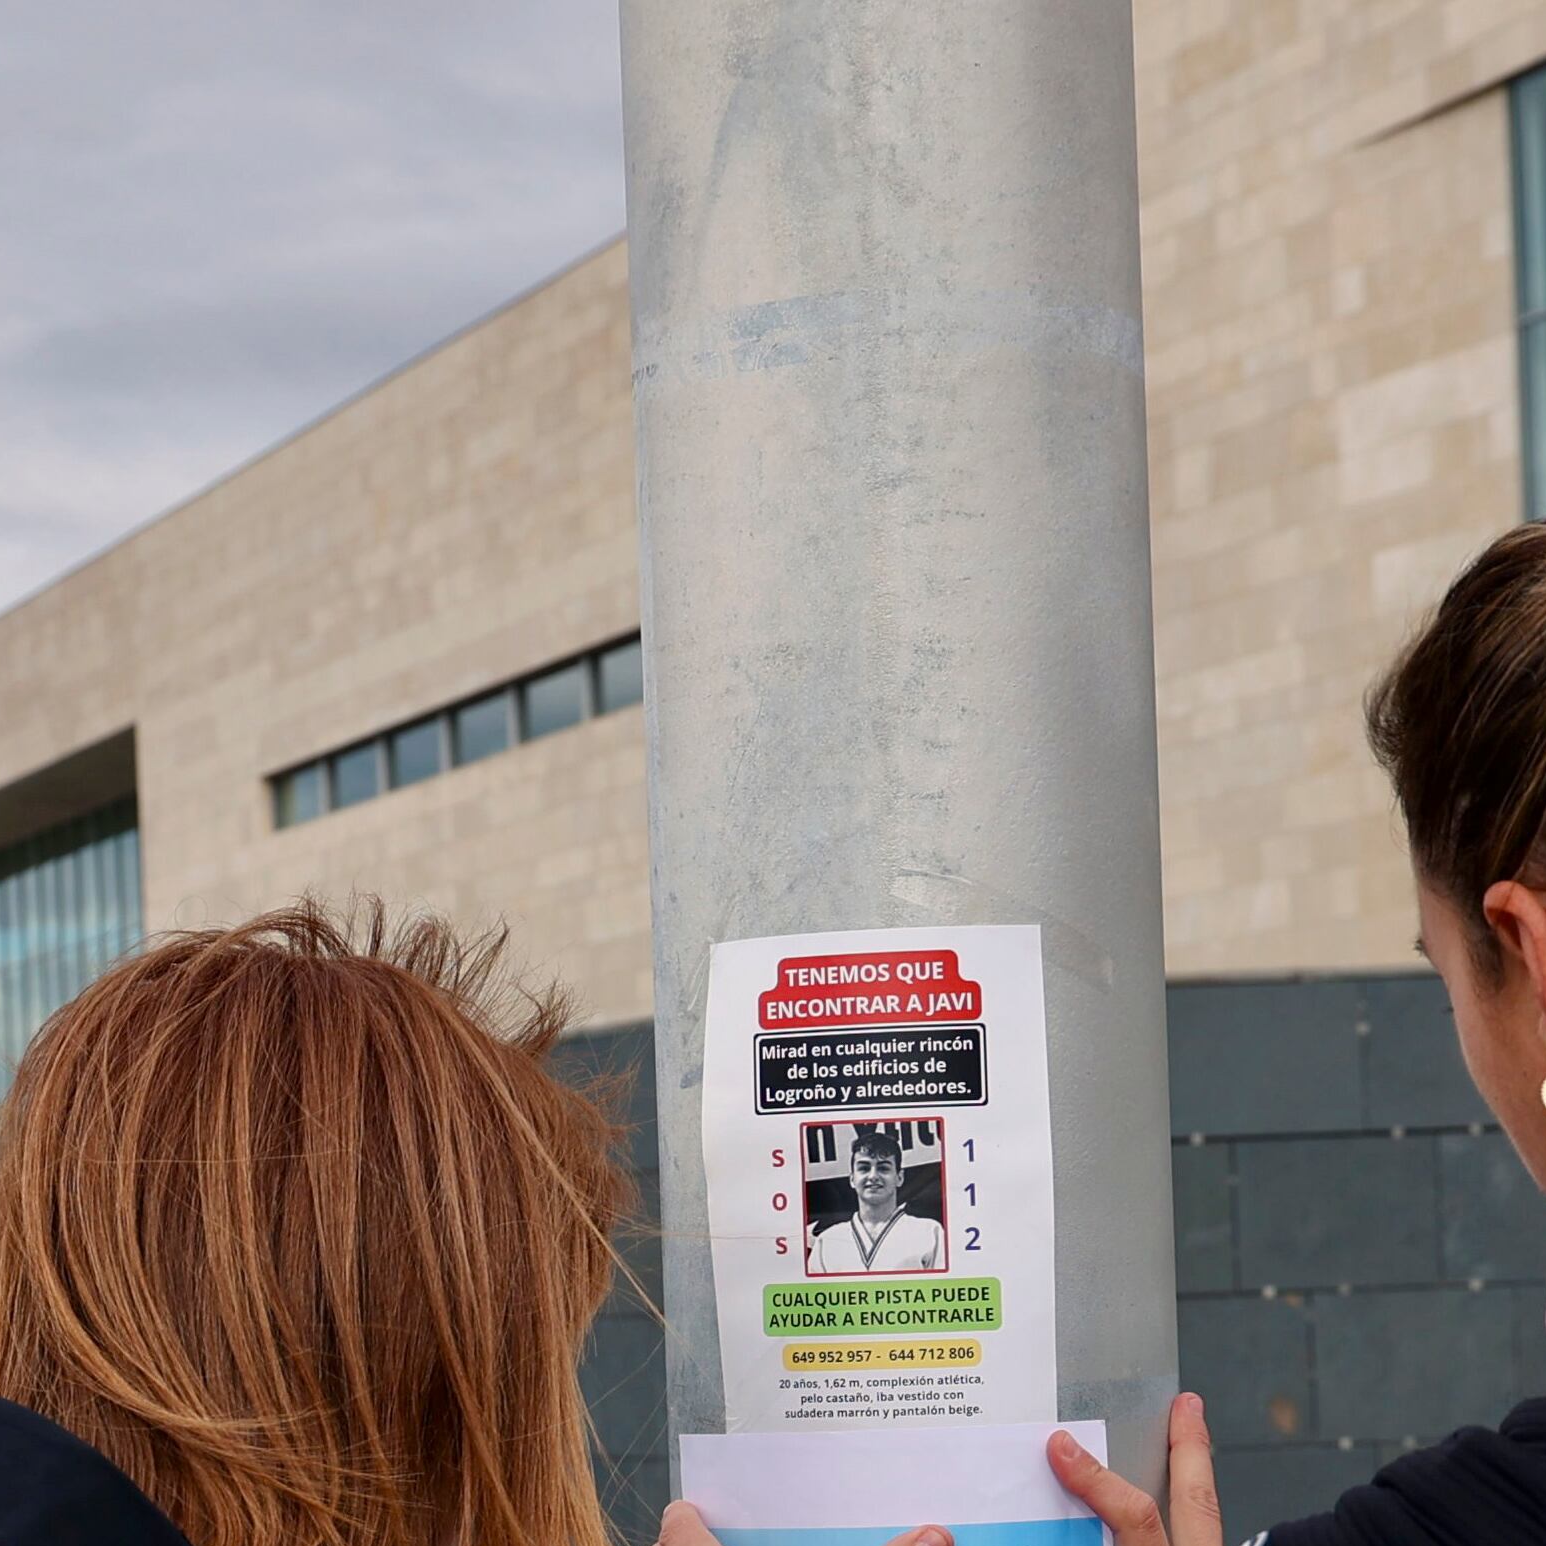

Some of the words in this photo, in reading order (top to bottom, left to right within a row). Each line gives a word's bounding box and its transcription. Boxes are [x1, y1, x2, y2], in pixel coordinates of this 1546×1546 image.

[785, 963, 890, 987] TENEMOS
[897, 961, 944, 984] QUE
[766, 995, 900, 1020] ENCONTRAR
[906, 995, 923, 1012] A
[926, 992, 973, 1016] JAVI
[762, 1043, 807, 1060] Mirad
[811, 1044, 831, 1057] en
[835, 1038, 914, 1057] cualquier
[919, 1036, 973, 1052] rincón
[787, 1064, 808, 1080] de
[813, 1063, 838, 1078] los
[842, 1059, 919, 1076] edificios
[924, 1057, 947, 1073] de
[765, 1084, 837, 1105] Logroño
[840, 1085, 852, 1102] y
[856, 1079, 972, 1098] alrededores.
[772, 1290, 869, 1309] CUALQUIER
[875, 1288, 924, 1304] PISTA
[932, 1286, 990, 1303] PUEDE
[769, 1312, 837, 1328] AYUDAR
[842, 1311, 855, 1326] A
[860, 1307, 995, 1326] ENCONTRARLE
[792, 1351, 815, 1364] 649
[818, 1350, 843, 1363] 952
[846, 1350, 872, 1363] 957
[889, 1349, 915, 1361] 644
[919, 1348, 945, 1360] 712
[949, 1347, 974, 1359] 806
[779, 1379, 791, 1389] 20
[793, 1378, 821, 1390] años,
[824, 1378, 846, 1390] 1,62
[866, 1376, 934, 1389] complexión
[800, 1394, 823, 1405] pelo
[825, 1393, 874, 1404] castaño,
[897, 1391, 940, 1402] vestido
[943, 1391, 964, 1401] con
[785, 1408, 834, 1419] sudadera
[837, 1406, 880, 1417] marrón
[882, 1408, 890, 1420] y
[892, 1404, 945, 1419] pantalón
